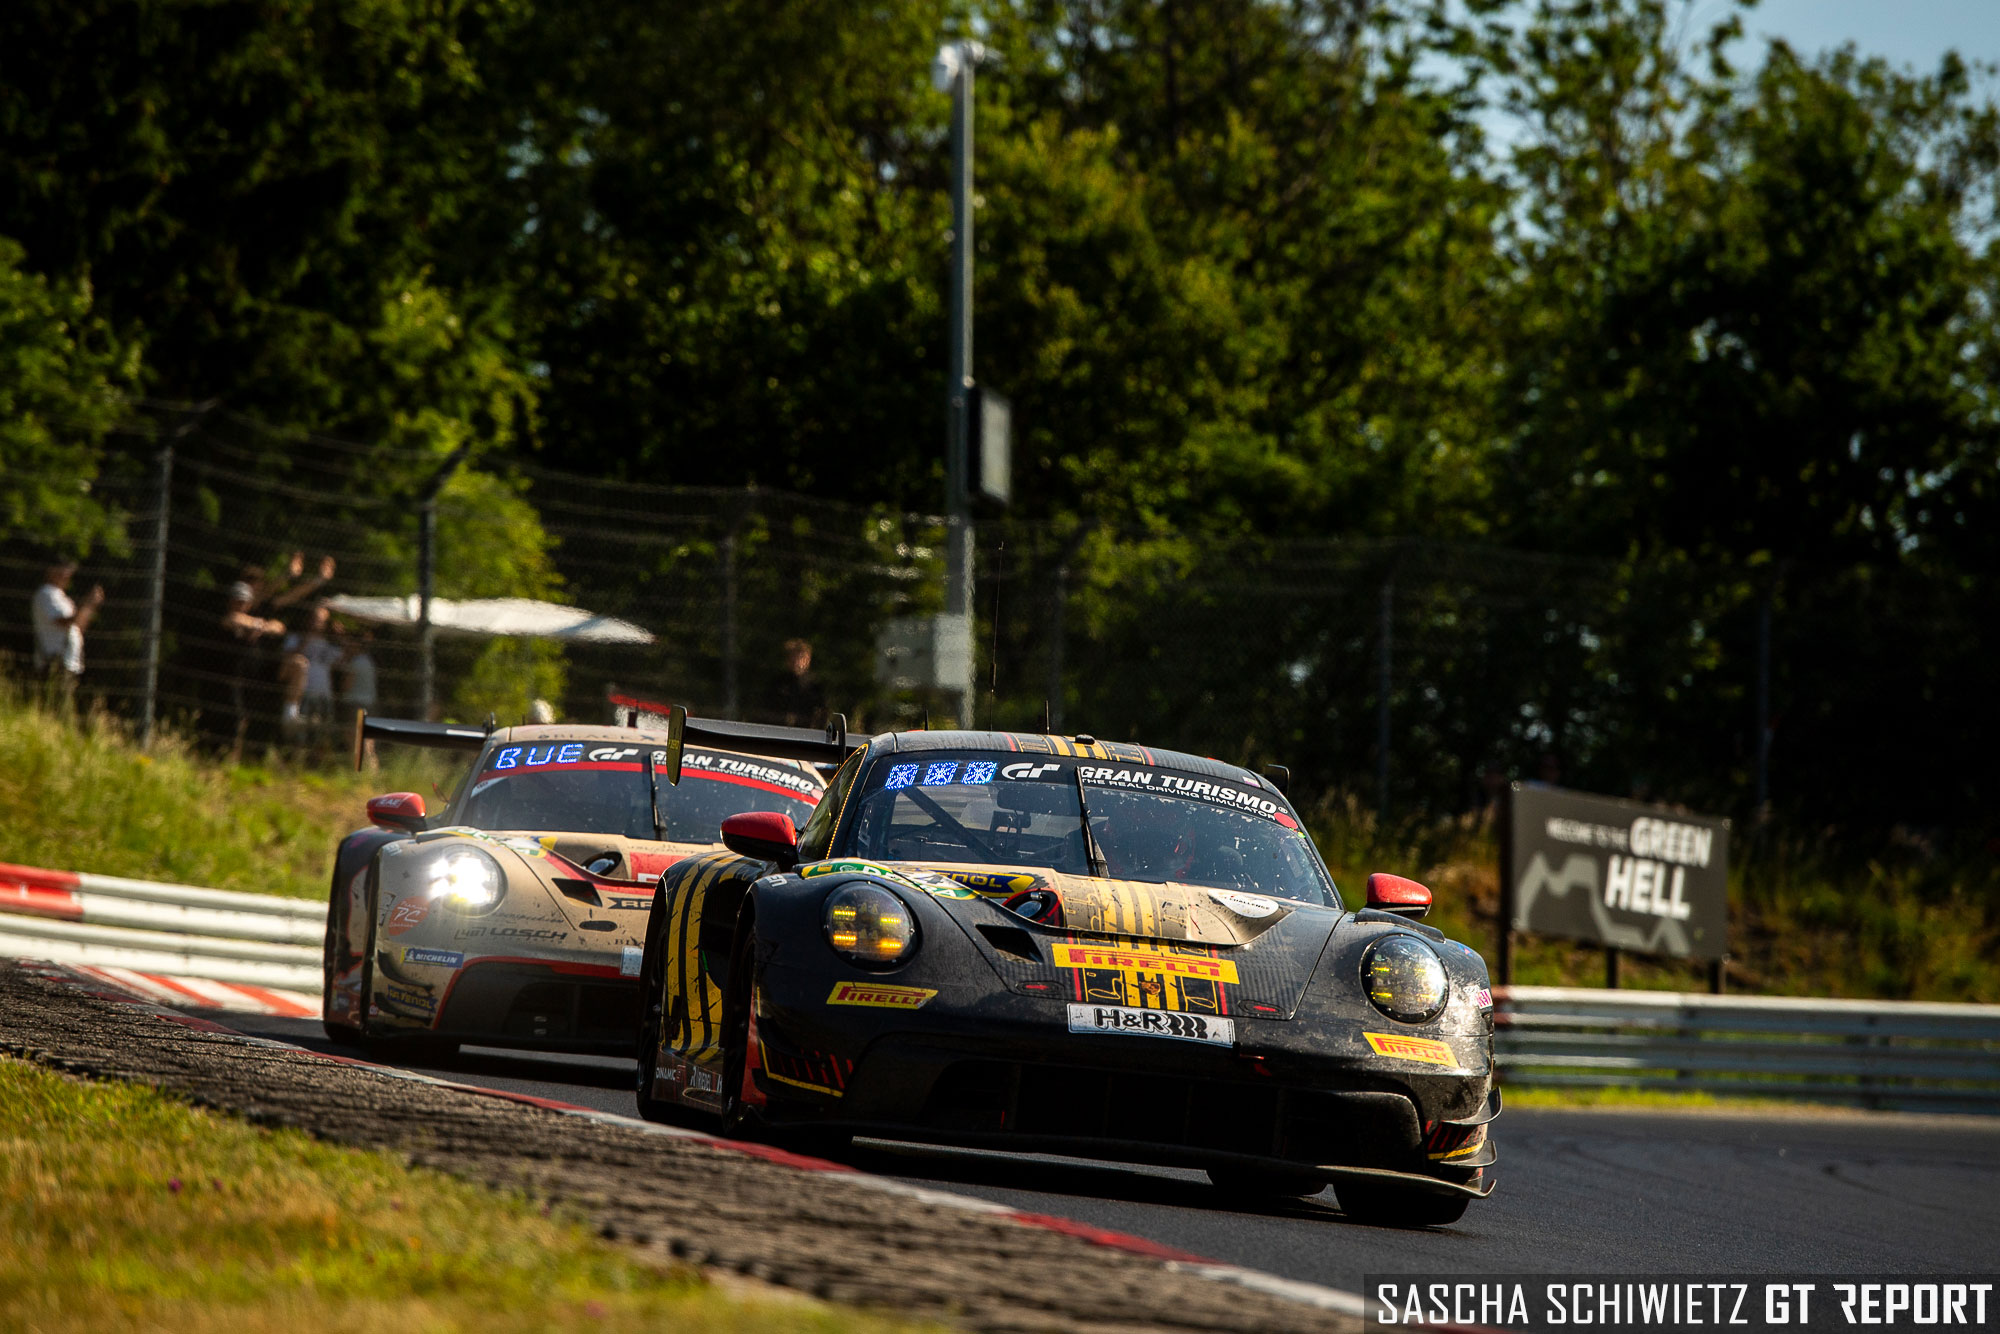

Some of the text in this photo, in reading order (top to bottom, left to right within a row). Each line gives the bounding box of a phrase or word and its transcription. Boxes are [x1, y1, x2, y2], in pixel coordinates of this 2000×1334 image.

[495, 743, 585, 770] BUE
[652, 750, 815, 792] GAN TURISMO
[1080, 766, 1277, 814] GRAN TURISMO
[1109, 780, 1144, 789] REAL
[1146, 785, 1200, 799] DRIVING
[1203, 795, 1276, 821] SIMULATOR
[1630, 816, 1712, 868] GREEN
[1604, 853, 1691, 920] HELL
[489, 927, 568, 940] LOSCH
[415, 953, 458, 964] MICHELIN
[1068, 948, 1221, 978] PIRELLI
[836, 985, 927, 1005] PIRELLI
[1094, 1008, 1166, 1032] H&R
[1374, 1037, 1450, 1062] PIRELLI
